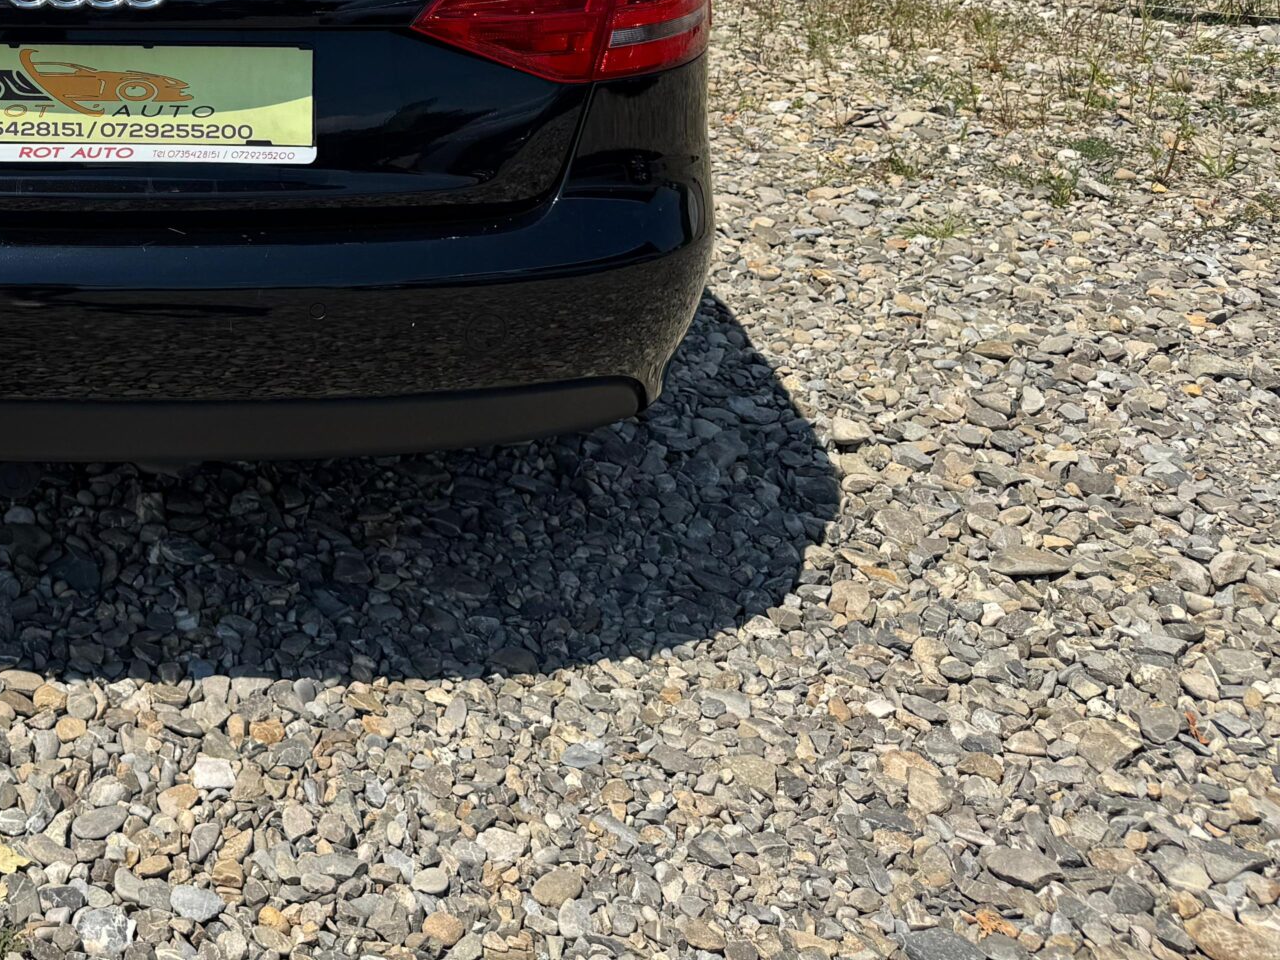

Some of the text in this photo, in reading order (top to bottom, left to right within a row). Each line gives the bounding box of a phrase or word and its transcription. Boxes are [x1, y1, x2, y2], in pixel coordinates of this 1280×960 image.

[112, 105, 216, 118] AUTO
[18, 147, 65, 159] ROT
[70, 147, 135, 159] AUTO
[167, 149, 220, 159] 0735428151
[231, 151, 296, 160] 0729255200
